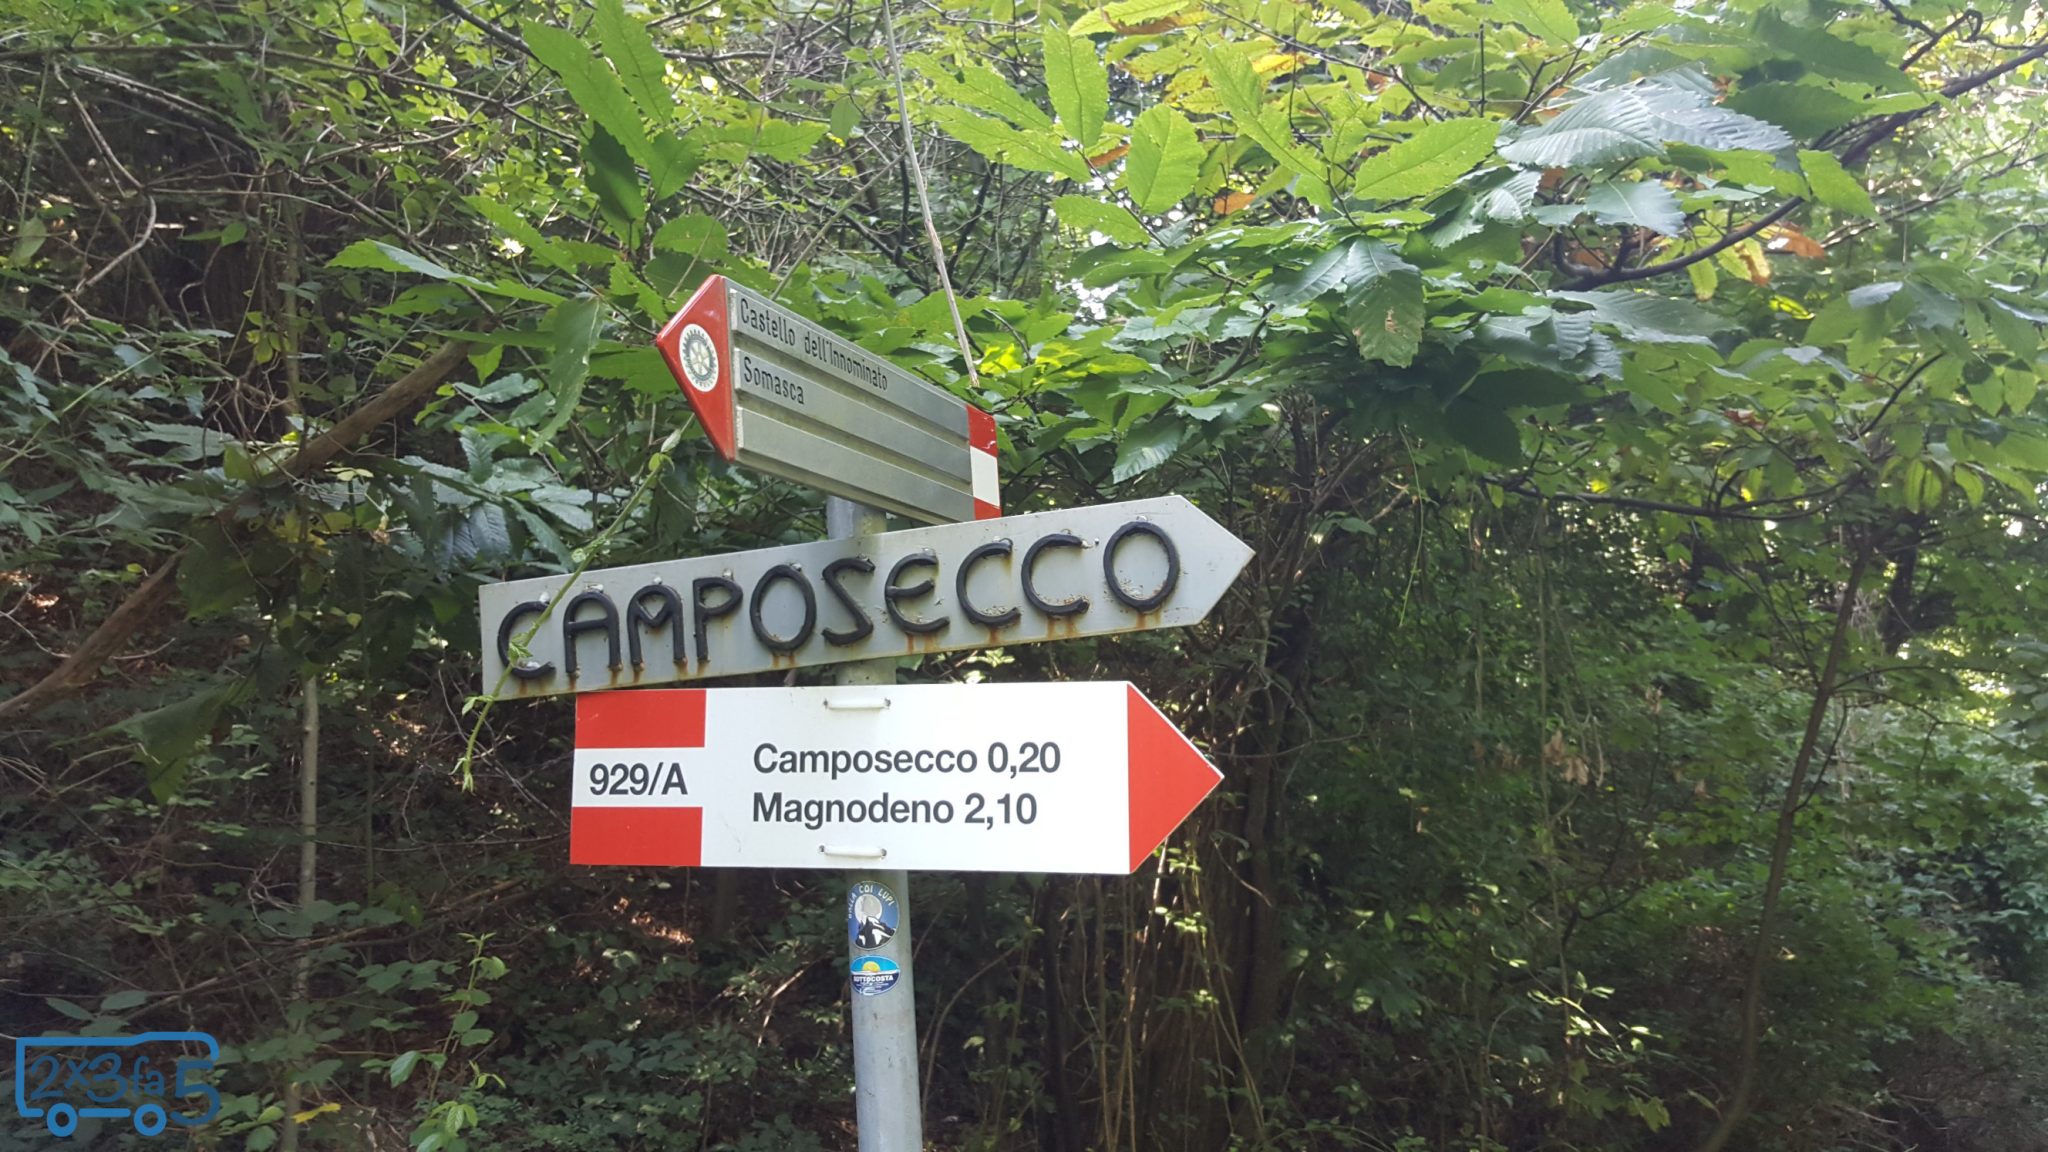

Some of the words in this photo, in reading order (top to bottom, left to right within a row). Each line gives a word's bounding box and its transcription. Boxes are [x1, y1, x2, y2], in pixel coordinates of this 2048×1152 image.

[740, 298, 796, 345] Castello
[804, 332, 888, 391] dell'Innominato
[744, 357, 804, 405] Somasca
[498, 520, 1180, 680] CAMPOSECCO
[588, 762, 688, 797] 929/A
[753, 743, 977, 780] Camposecco
[987, 742, 1061, 779] 0,20
[752, 792, 954, 830] Magnodeno
[965, 793, 1037, 830] 2,10
[878, 888, 895, 906] LUPI
